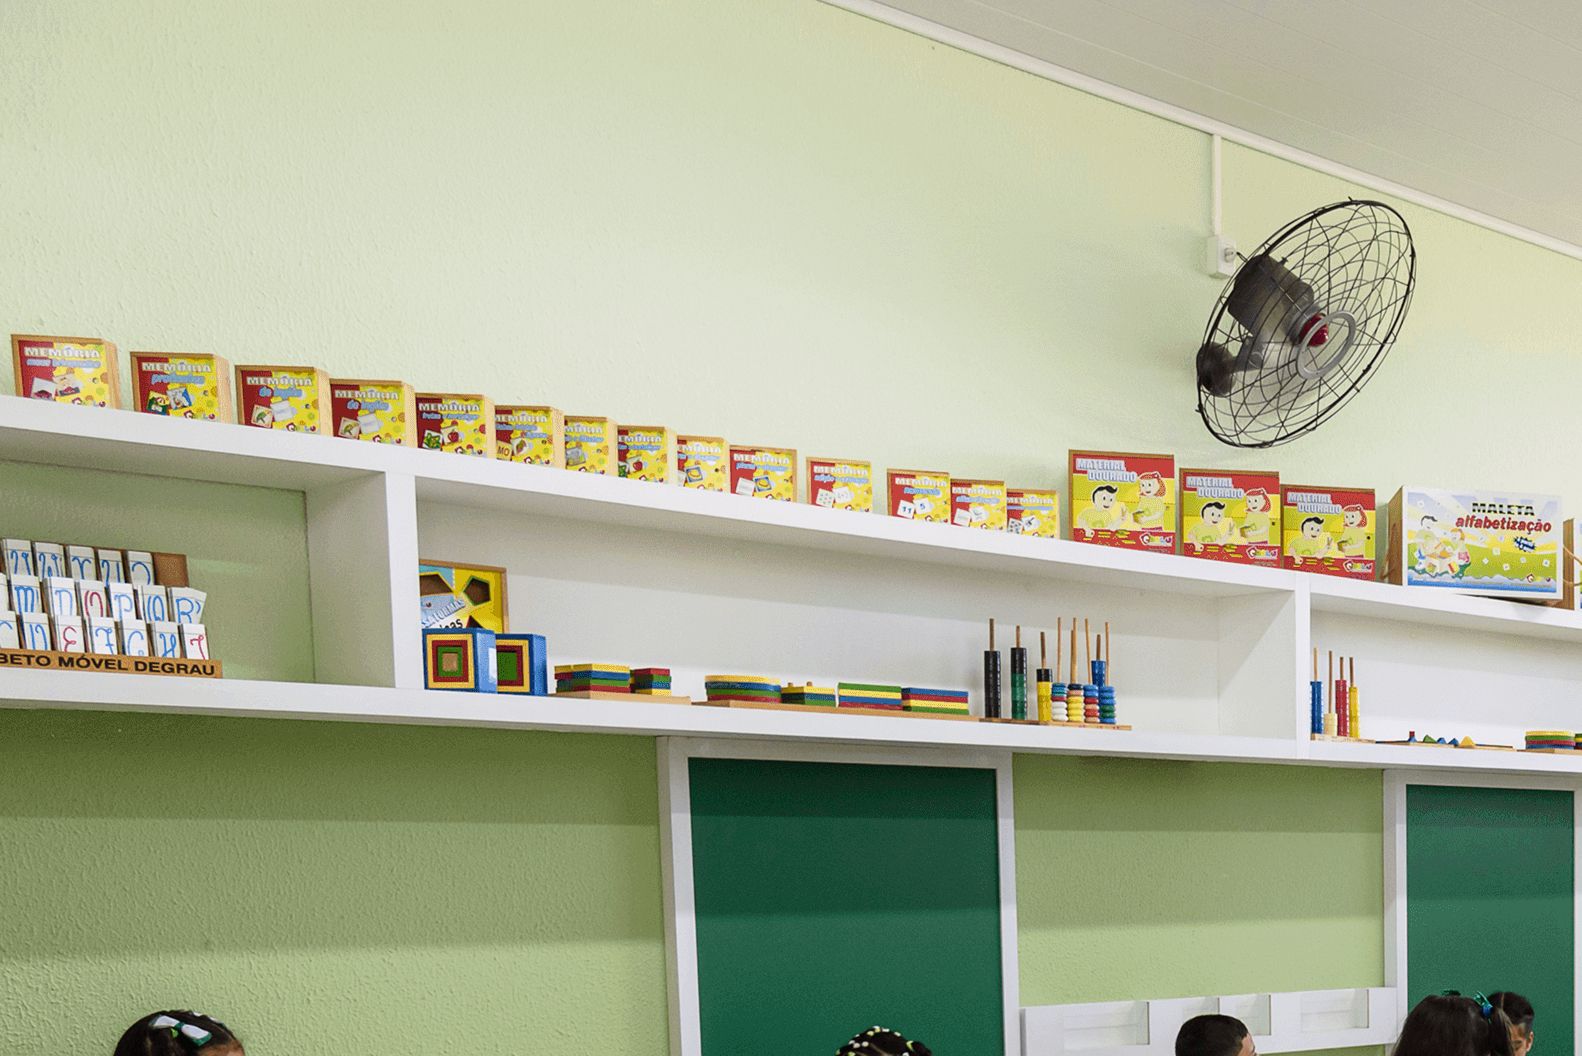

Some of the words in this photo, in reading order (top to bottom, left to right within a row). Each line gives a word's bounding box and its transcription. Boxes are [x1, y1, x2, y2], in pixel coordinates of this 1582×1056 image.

[24, 345, 101, 358] MEMÓRIA
[141, 361, 211, 373] MEMÓRIA
[247, 374, 313, 386] MEMÓRIA
[334, 387, 400, 400] MEMÓRIA
[418, 401, 480, 411] MEMÓRIA
[1076, 458, 1127, 472] MATERIAL
[1087, 470, 1138, 483] DOURADO
[1186, 476, 1233, 489] MATERIAL
[1197, 487, 1245, 499] DOURADO
[1287, 492, 1332, 505] MATERIAL
[1297, 502, 1342, 514] DOURADO
[1471, 502, 1535, 516] MALETA
[1455, 515, 1552, 535] alfabetização
[58, 654, 129, 671] MÓVEL
[134, 660, 215, 676] DEGRAU
